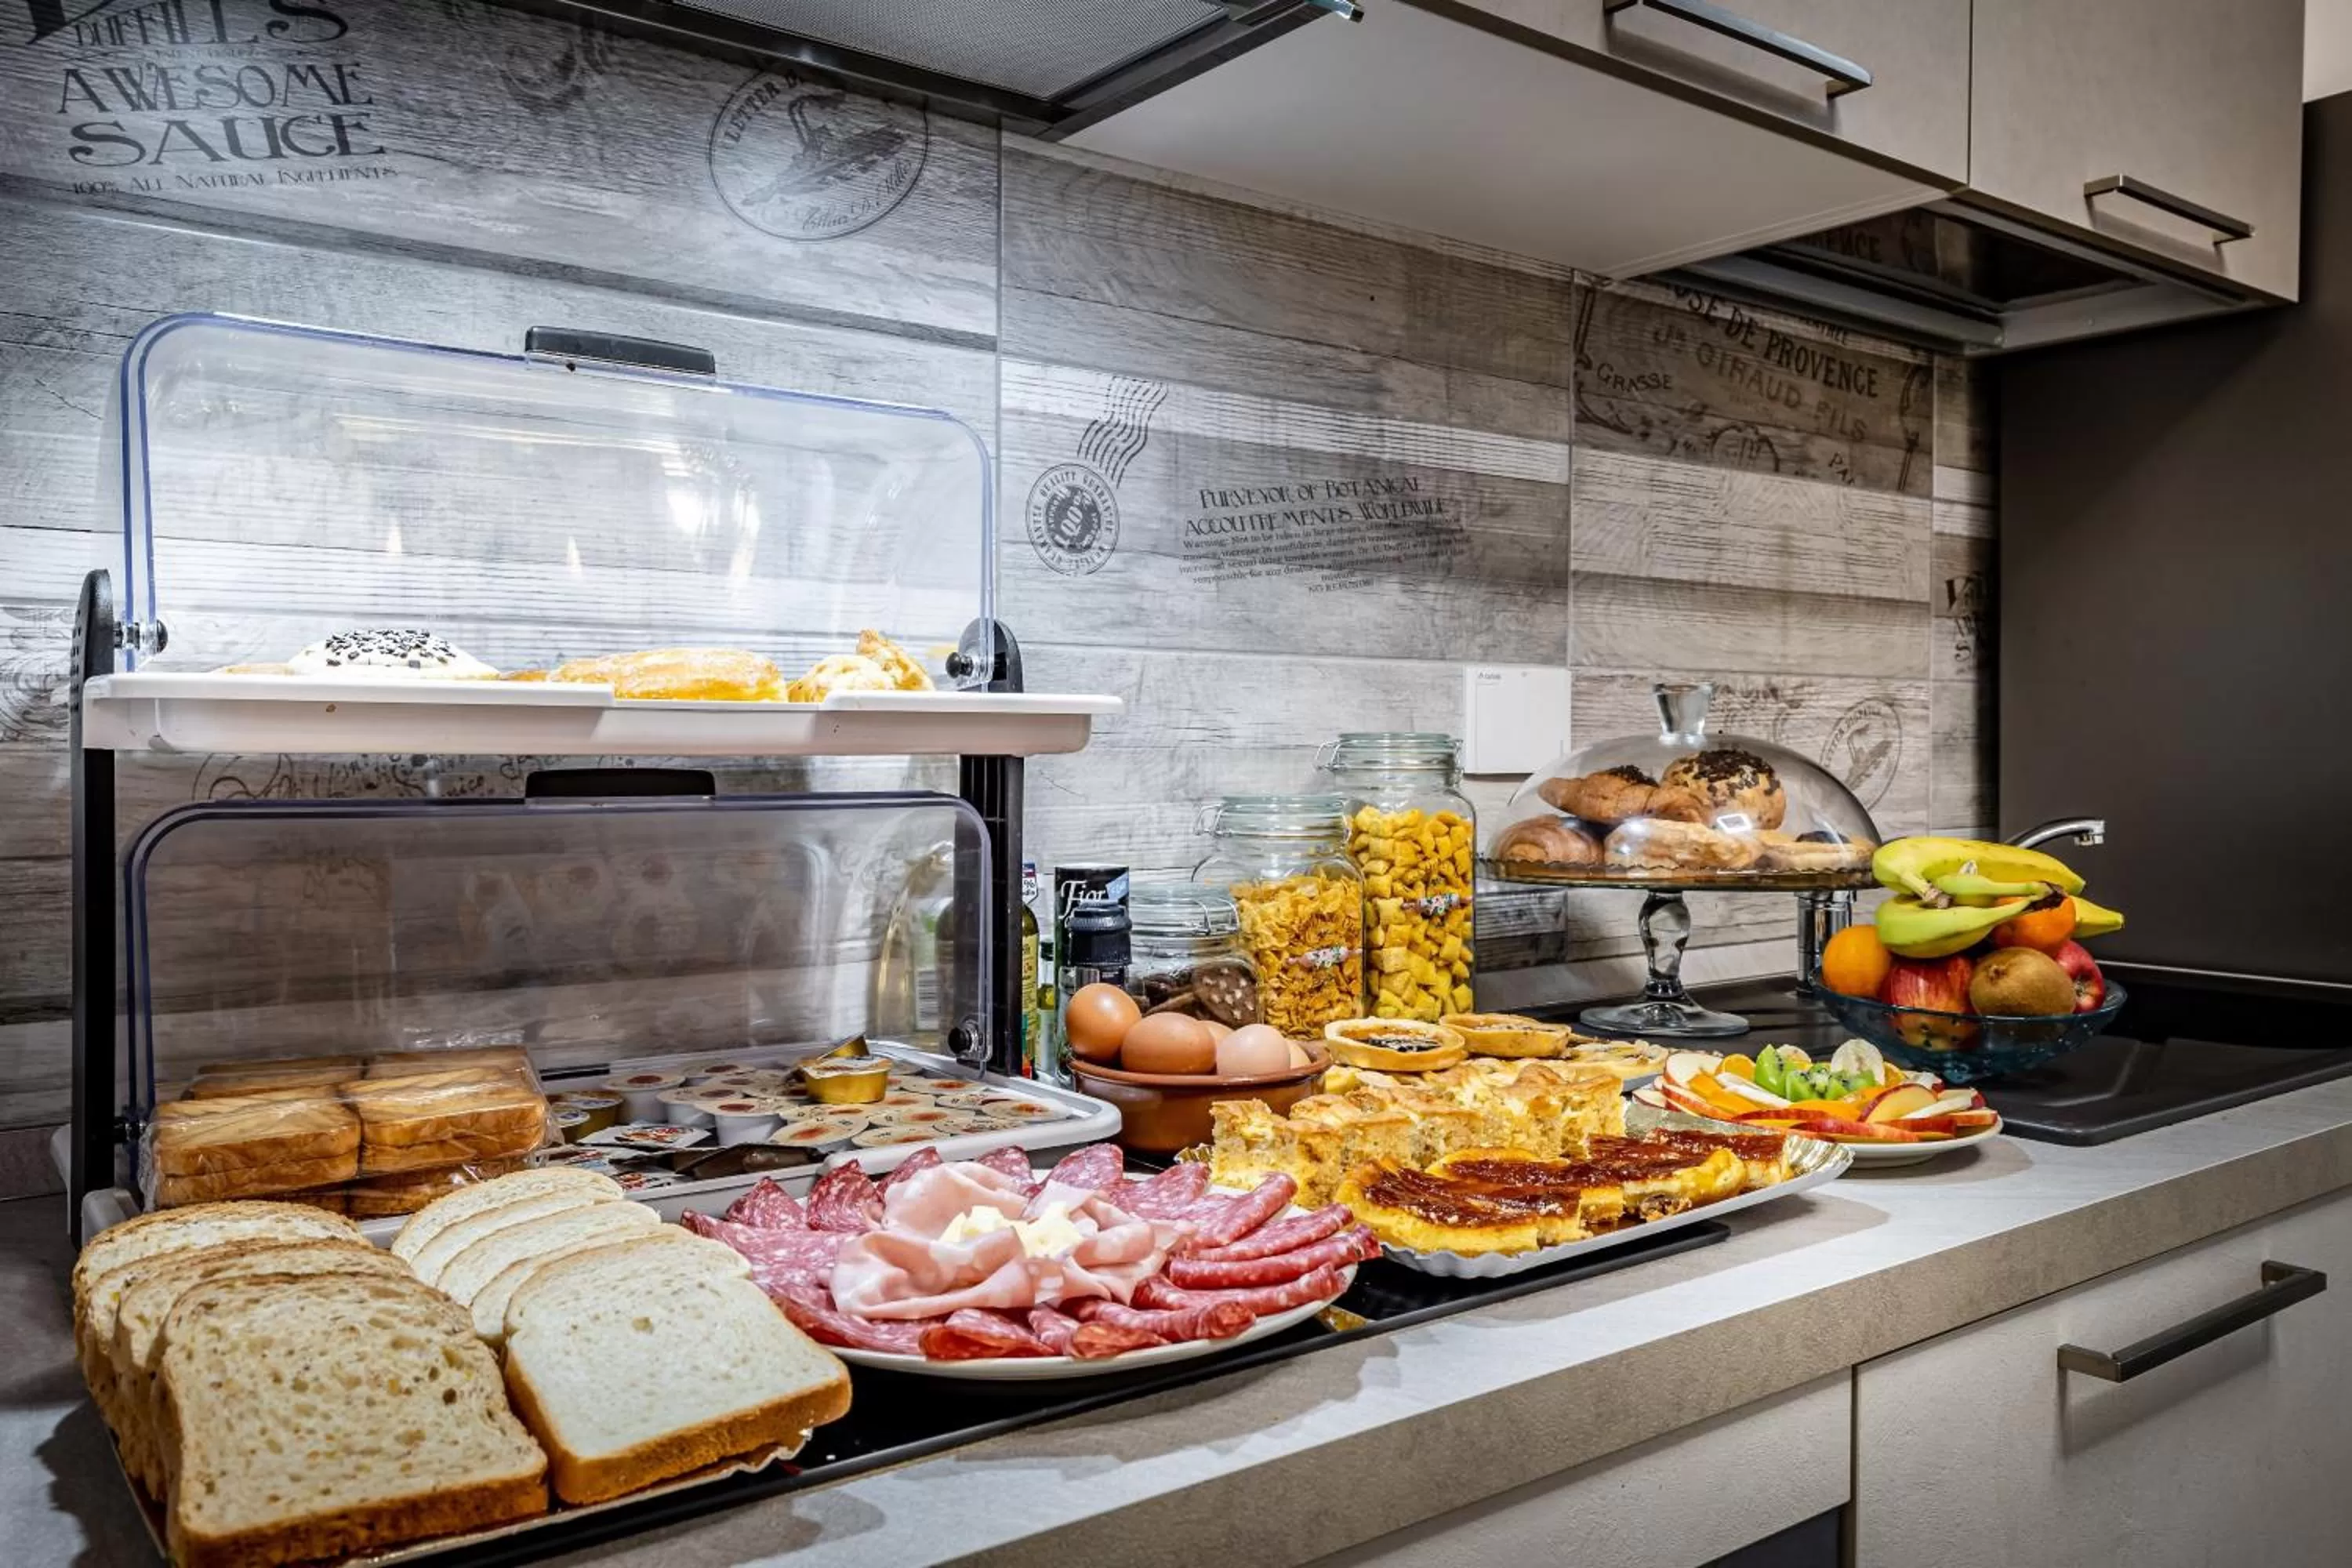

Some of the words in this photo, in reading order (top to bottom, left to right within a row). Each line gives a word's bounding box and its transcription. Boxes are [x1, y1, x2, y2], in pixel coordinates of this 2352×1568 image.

[57, 62, 374, 114] AWESOME
[68, 112, 386, 167] SAUCE
[1726, 306, 1759, 350] DE
[1763, 328, 1880, 398] PROVENCE
[1596, 362, 1674, 391] GRASSE
[1813, 400, 1868, 441] FILS
[1058, 880, 1107, 920] Fior
